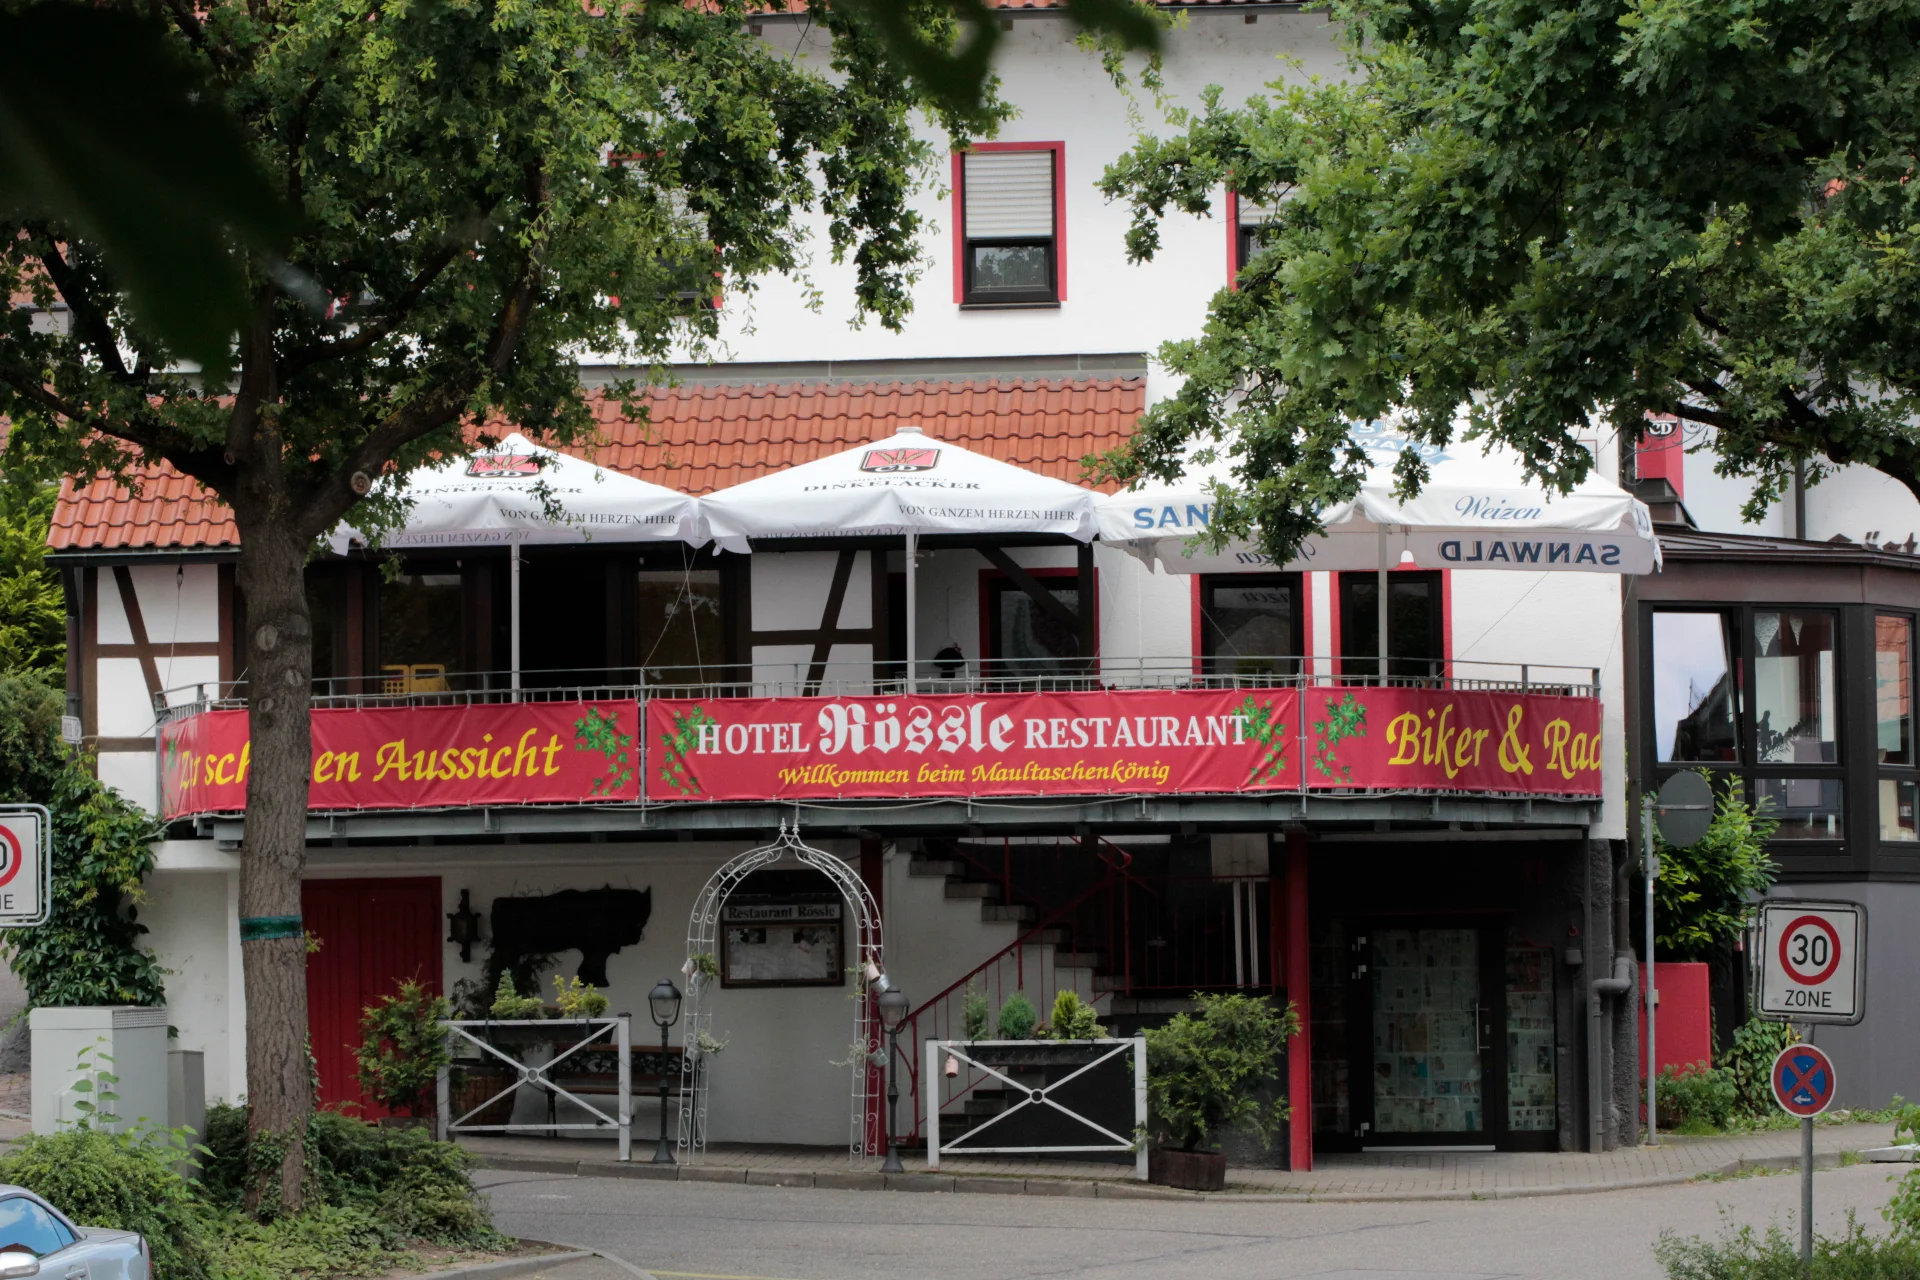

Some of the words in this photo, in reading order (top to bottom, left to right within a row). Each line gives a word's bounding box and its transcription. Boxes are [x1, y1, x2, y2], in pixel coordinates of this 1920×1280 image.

[802, 479, 982, 492] DINKELACKER
[500, 508, 527, 519] VON
[589, 513, 642, 524] HERZEN
[644, 514, 679, 525] HIER.
[898, 504, 926, 515] VON
[929, 507, 985, 518] GANZEM
[988, 509, 1042, 520] HERZEN
[1044, 510, 1079, 521] HIER.
[1455, 495, 1543, 520] Weizen
[696, 722, 810, 754] HOTEL
[818, 702, 1015, 755] Rössle
[1023, 715, 1249, 749] RESTAURANT
[1386, 704, 1489, 780] Biker
[1498, 703, 1534, 775] &
[373, 727, 563, 783] Aussicht
[778, 763, 909, 787] Willkommen
[916, 762, 966, 784] beim
[971, 759, 1170, 786] Maultaschenkönig
[728, 906, 793, 919] Restaurant
[1791, 933, 1828, 967] 30
[1784, 989, 1832, 1008] ZONE
